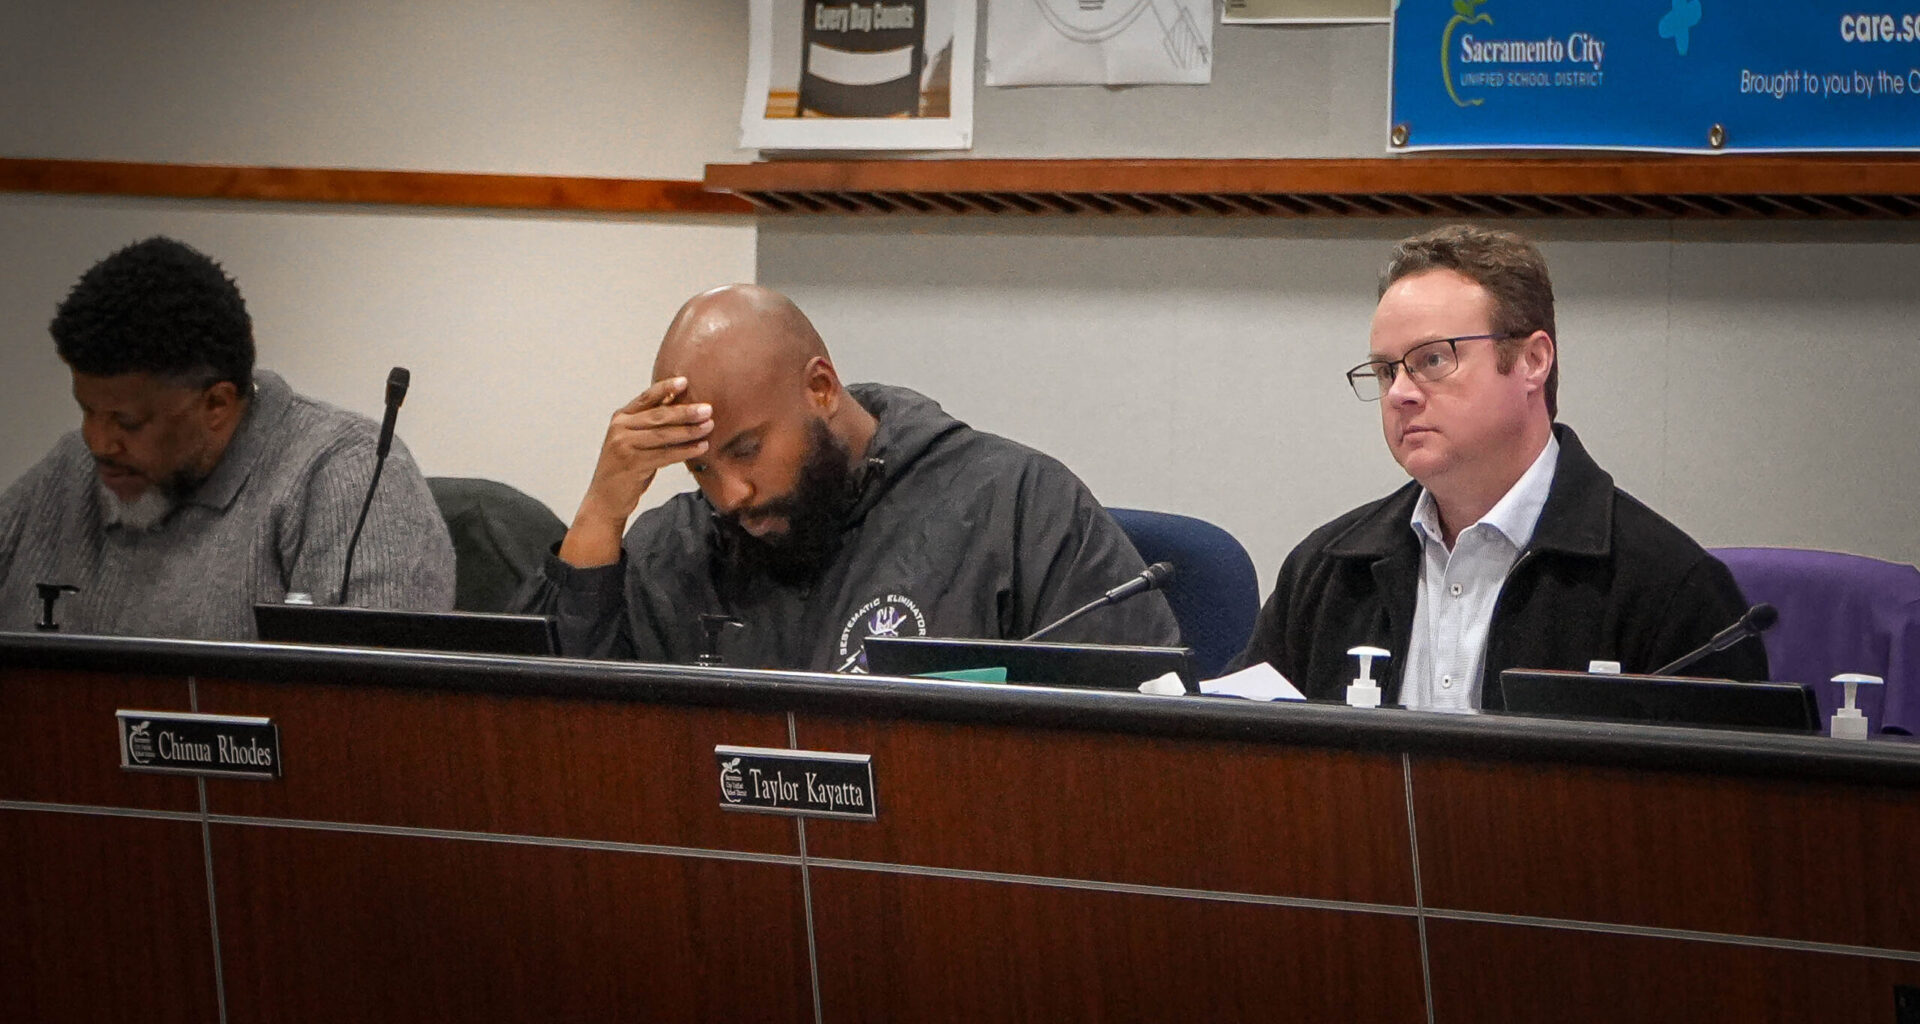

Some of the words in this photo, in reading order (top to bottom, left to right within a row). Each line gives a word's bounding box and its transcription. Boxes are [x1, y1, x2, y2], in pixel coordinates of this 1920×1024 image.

[815, 2, 848, 33] Every
[850, 2, 872, 32] Day
[873, 2, 914, 30] Counts
[1461, 33, 1564, 63] Sacramento
[1567, 32, 1605, 70] City
[1460, 71, 1505, 88] UNIFIED
[1507, 71, 1551, 88] SCHOOL
[1554, 71, 1603, 88] DISTRICT
[1740, 69, 1800, 99] Brought
[1803, 70, 1819, 94] to
[1822, 74, 1851, 99] you
[1854, 70, 1874, 99] by
[1878, 70, 1905, 94] the
[158, 731, 212, 763] Chinua
[217, 734, 272, 766] Rhodes
[749, 768, 799, 806] Taylor
[805, 772, 865, 810] Kayatta
